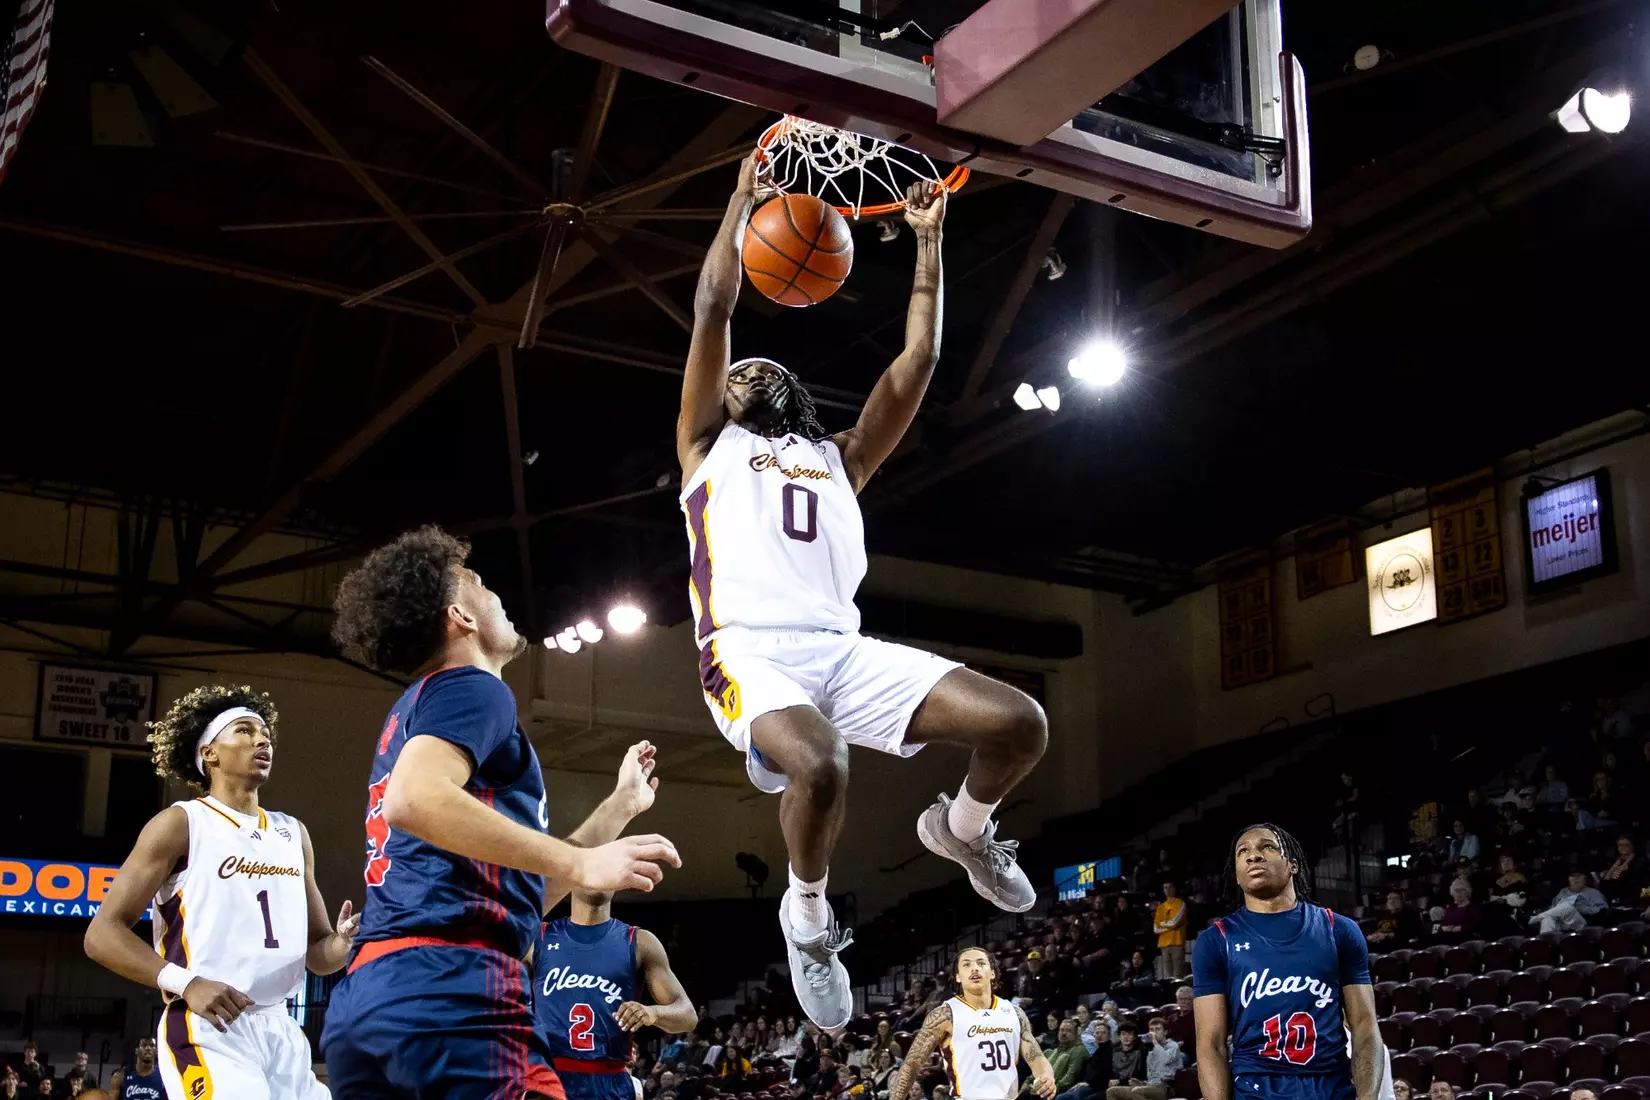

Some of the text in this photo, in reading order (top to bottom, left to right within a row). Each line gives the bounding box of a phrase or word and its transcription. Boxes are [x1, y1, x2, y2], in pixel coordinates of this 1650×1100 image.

[782, 482, 818, 543] 0
[1532, 512, 1598, 548] meijer
[59, 720, 109, 739] SWEET
[218, 855, 301, 880] Chippewas
[256, 890, 279, 948] 1
[543, 966, 622, 1004] Cleary
[1240, 968, 1333, 1008] Cleary
[568, 1003, 595, 1051] 2
[967, 1025, 1013, 1038] Chippewas
[1259, 1012, 1317, 1065] 10
[978, 1039, 1011, 1071] 30
[126, 1084, 159, 1100] Cleary
